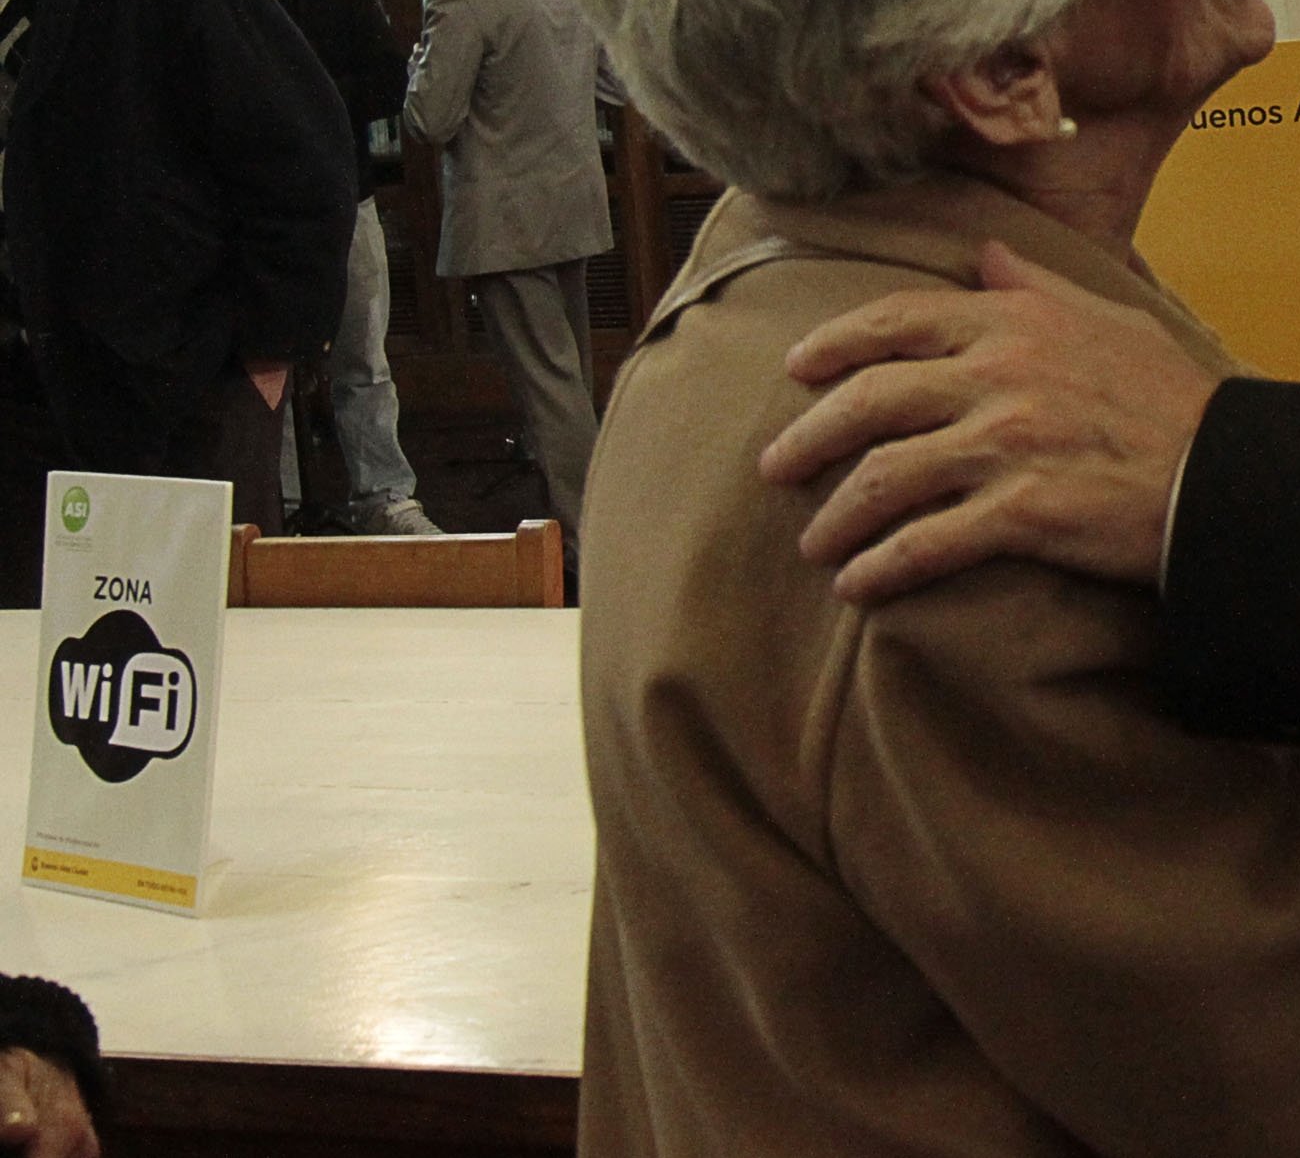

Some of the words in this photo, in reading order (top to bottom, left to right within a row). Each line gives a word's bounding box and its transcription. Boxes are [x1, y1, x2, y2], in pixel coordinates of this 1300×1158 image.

[1190, 104, 1283, 130] uenos
[64, 501, 88, 518] ASI
[94, 576, 153, 605] ZONA
